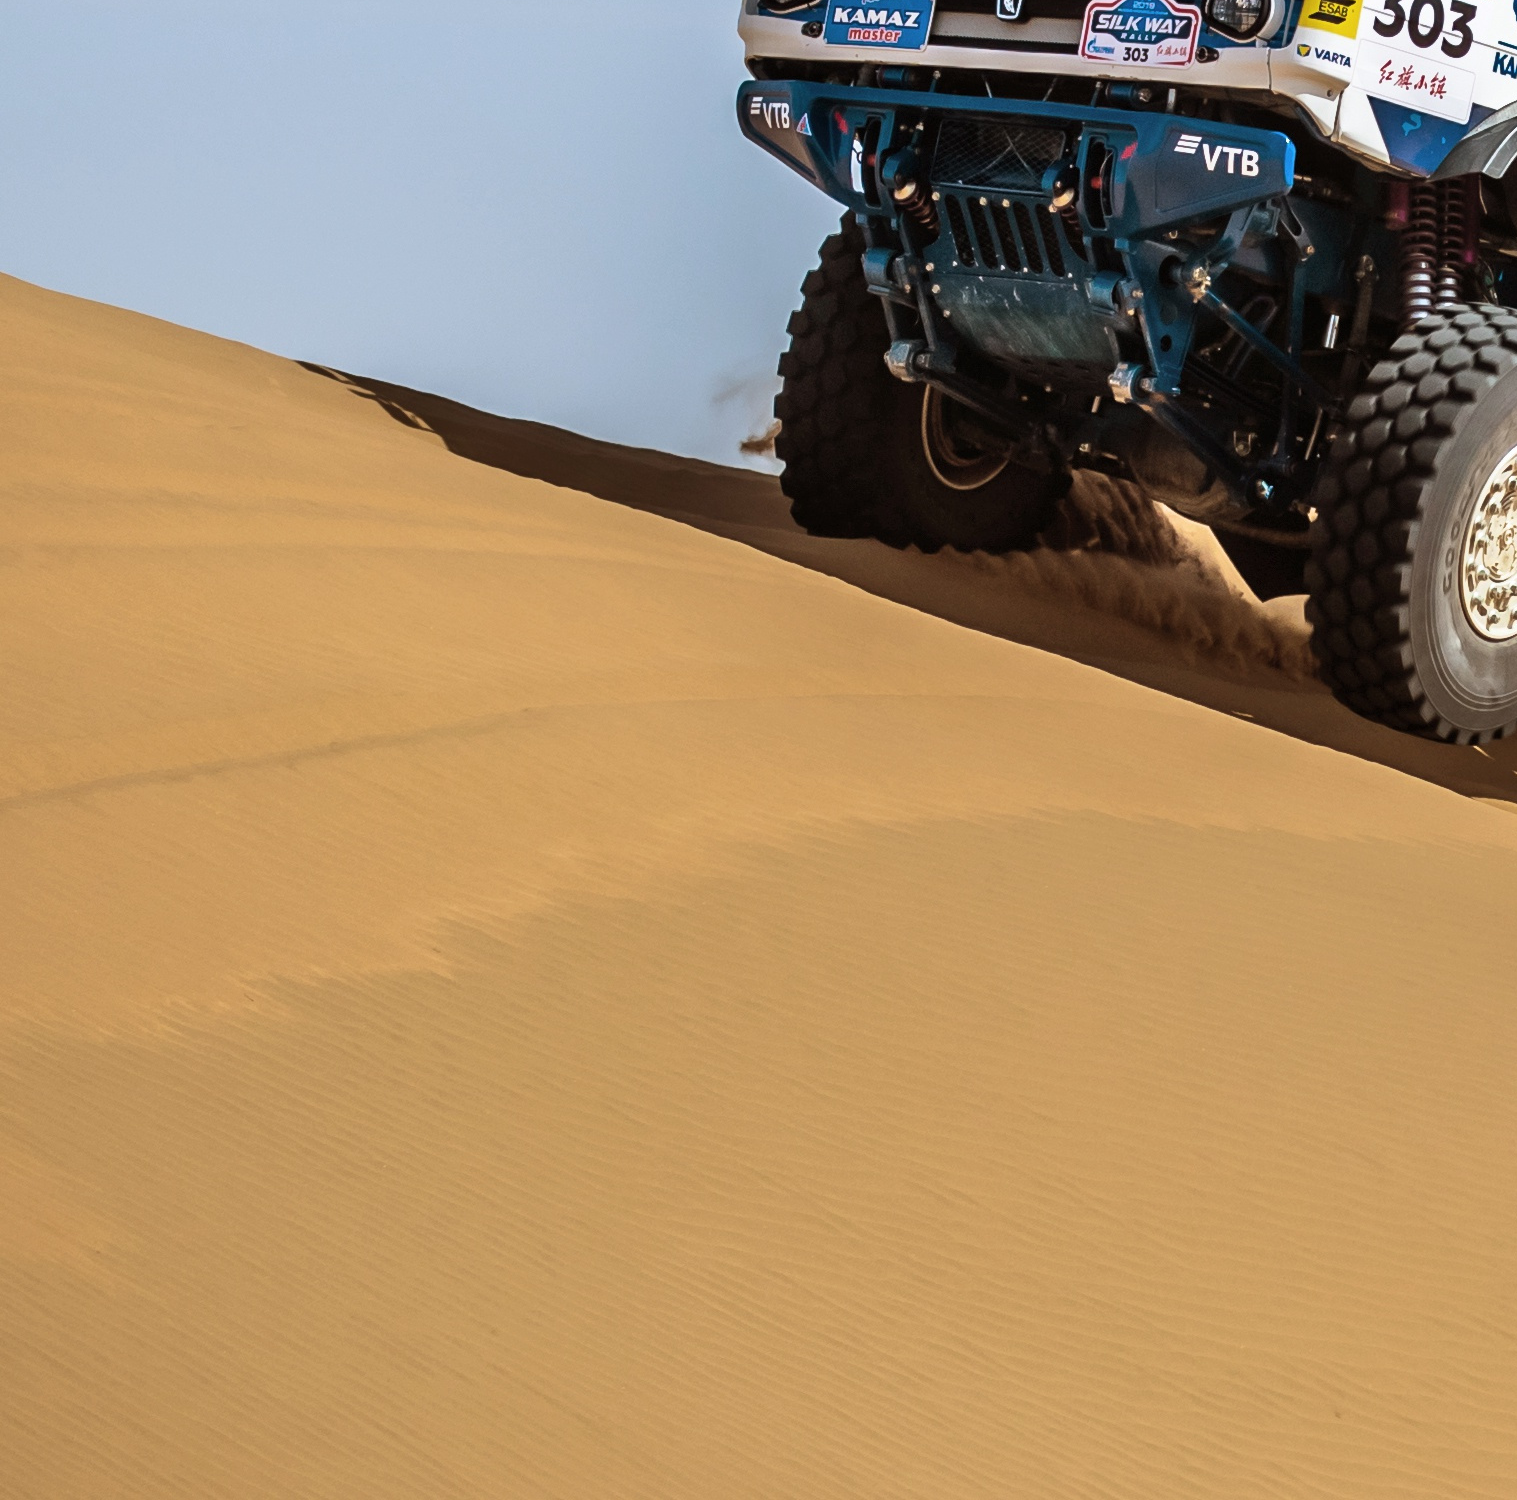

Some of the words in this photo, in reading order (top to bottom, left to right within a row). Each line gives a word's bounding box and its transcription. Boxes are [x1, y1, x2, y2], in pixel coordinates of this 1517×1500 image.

[832, 7, 920, 28] KAMAZ
[1318, 0, 1349, 18] ESAB
[847, 26, 902, 43] master
[1095, 13, 1143, 31] SILK
[1144, 17, 1188, 35] WAY
[1120, 32, 1157, 41] RALLY
[1122, 46, 1149, 62] 303
[1314, 47, 1352, 68] VARTA
[762, 102, 790, 129] VTB
[1202, 143, 1260, 177] VTB
